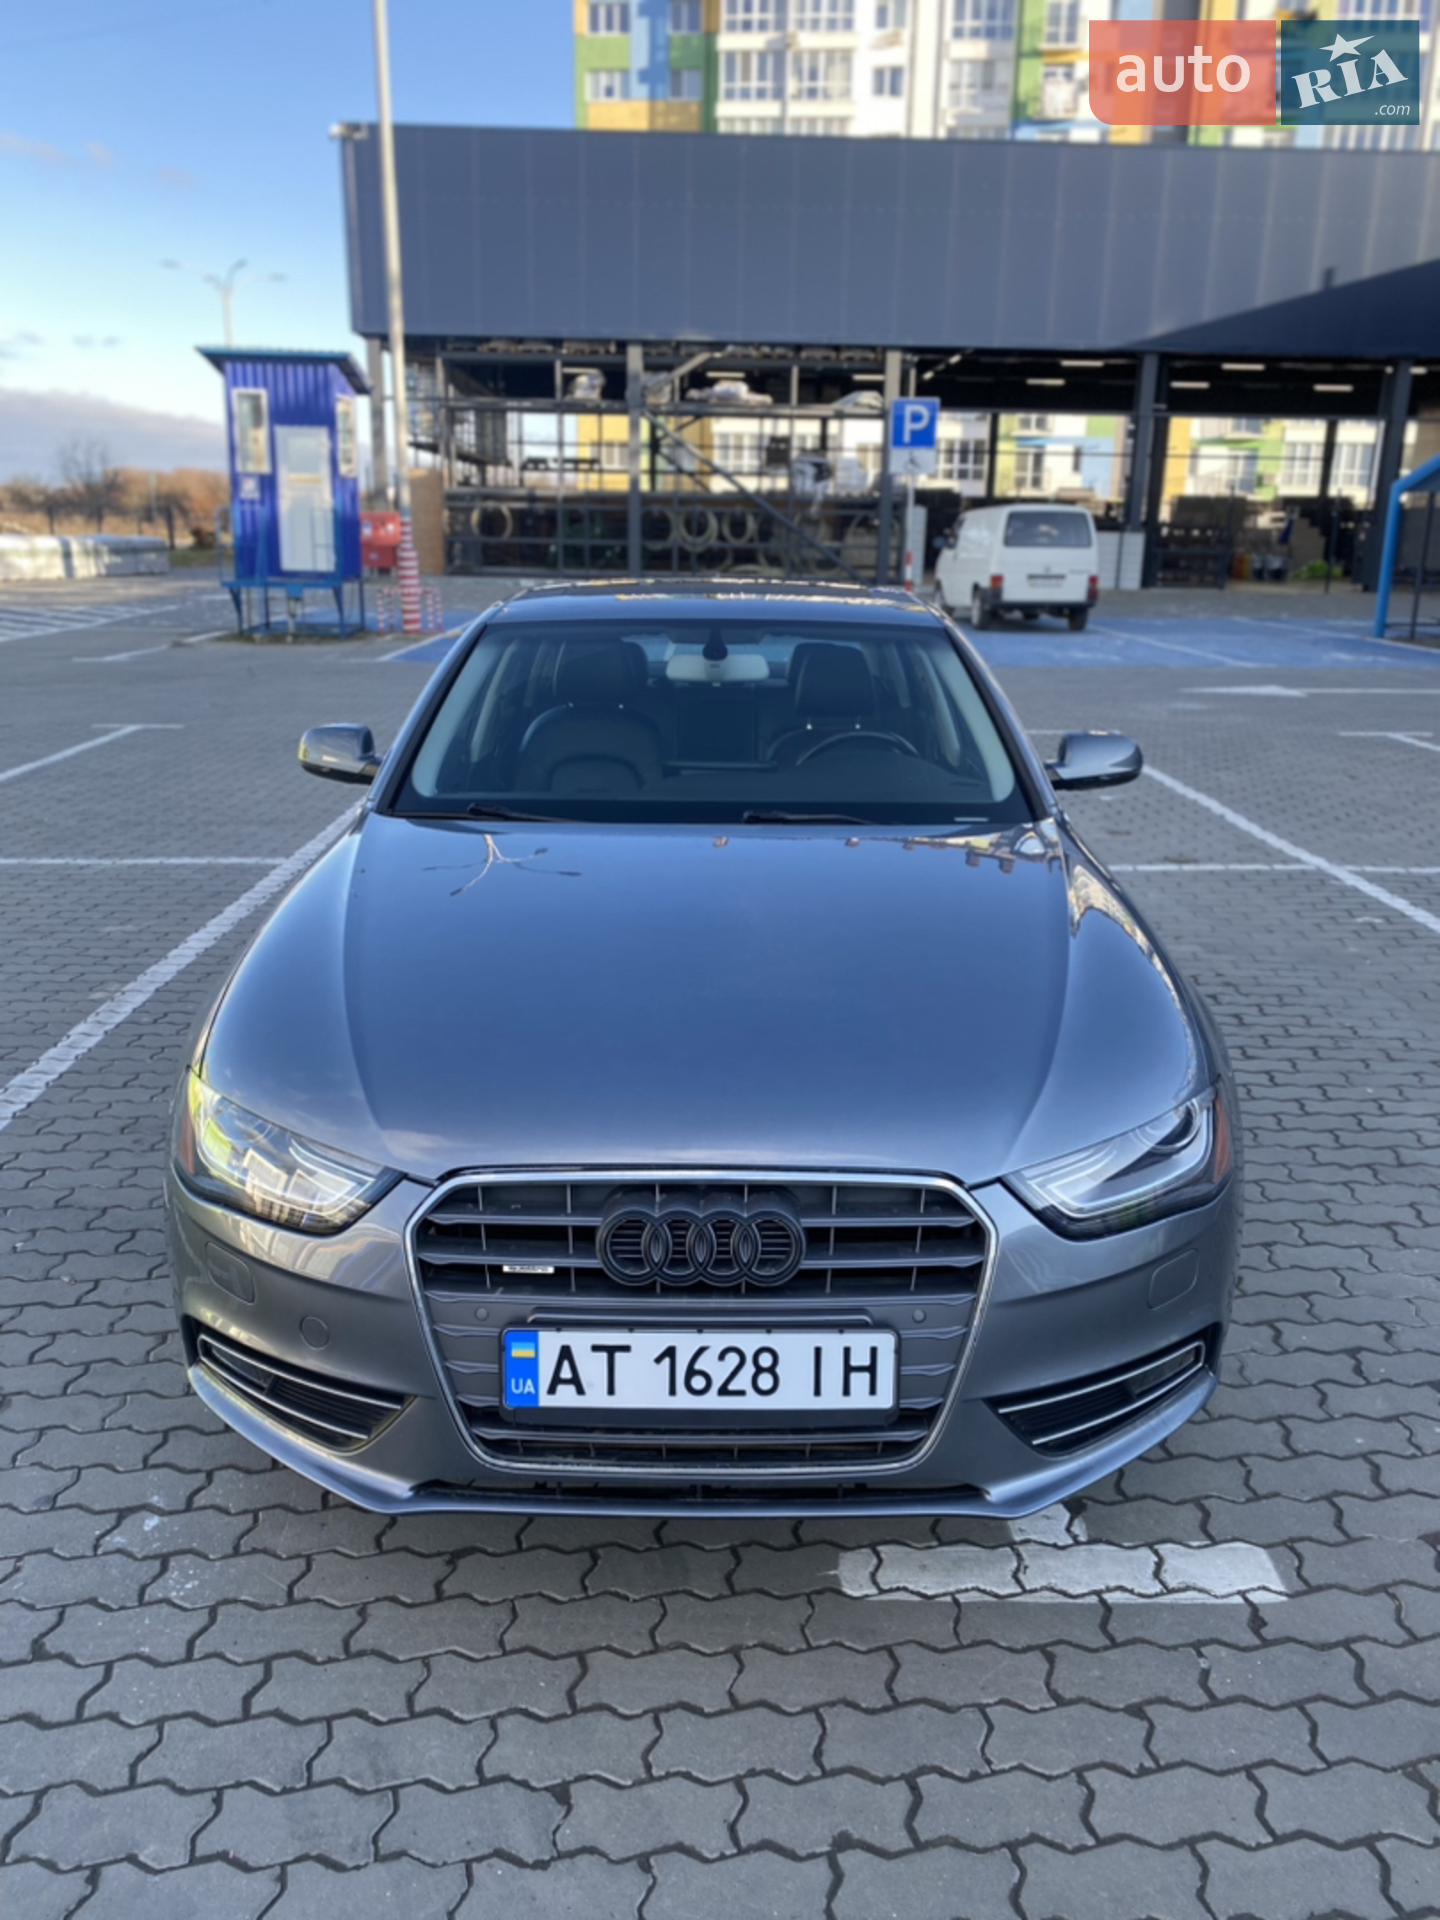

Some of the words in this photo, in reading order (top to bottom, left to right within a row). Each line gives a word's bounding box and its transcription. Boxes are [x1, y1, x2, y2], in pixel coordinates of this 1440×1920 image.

[903, 404, 930, 444] P
[511, 1378, 535, 1394] UA
[546, 1345, 631, 1396] AT
[653, 1345, 780, 1397] 1628
[814, 1346, 878, 1397] IH
